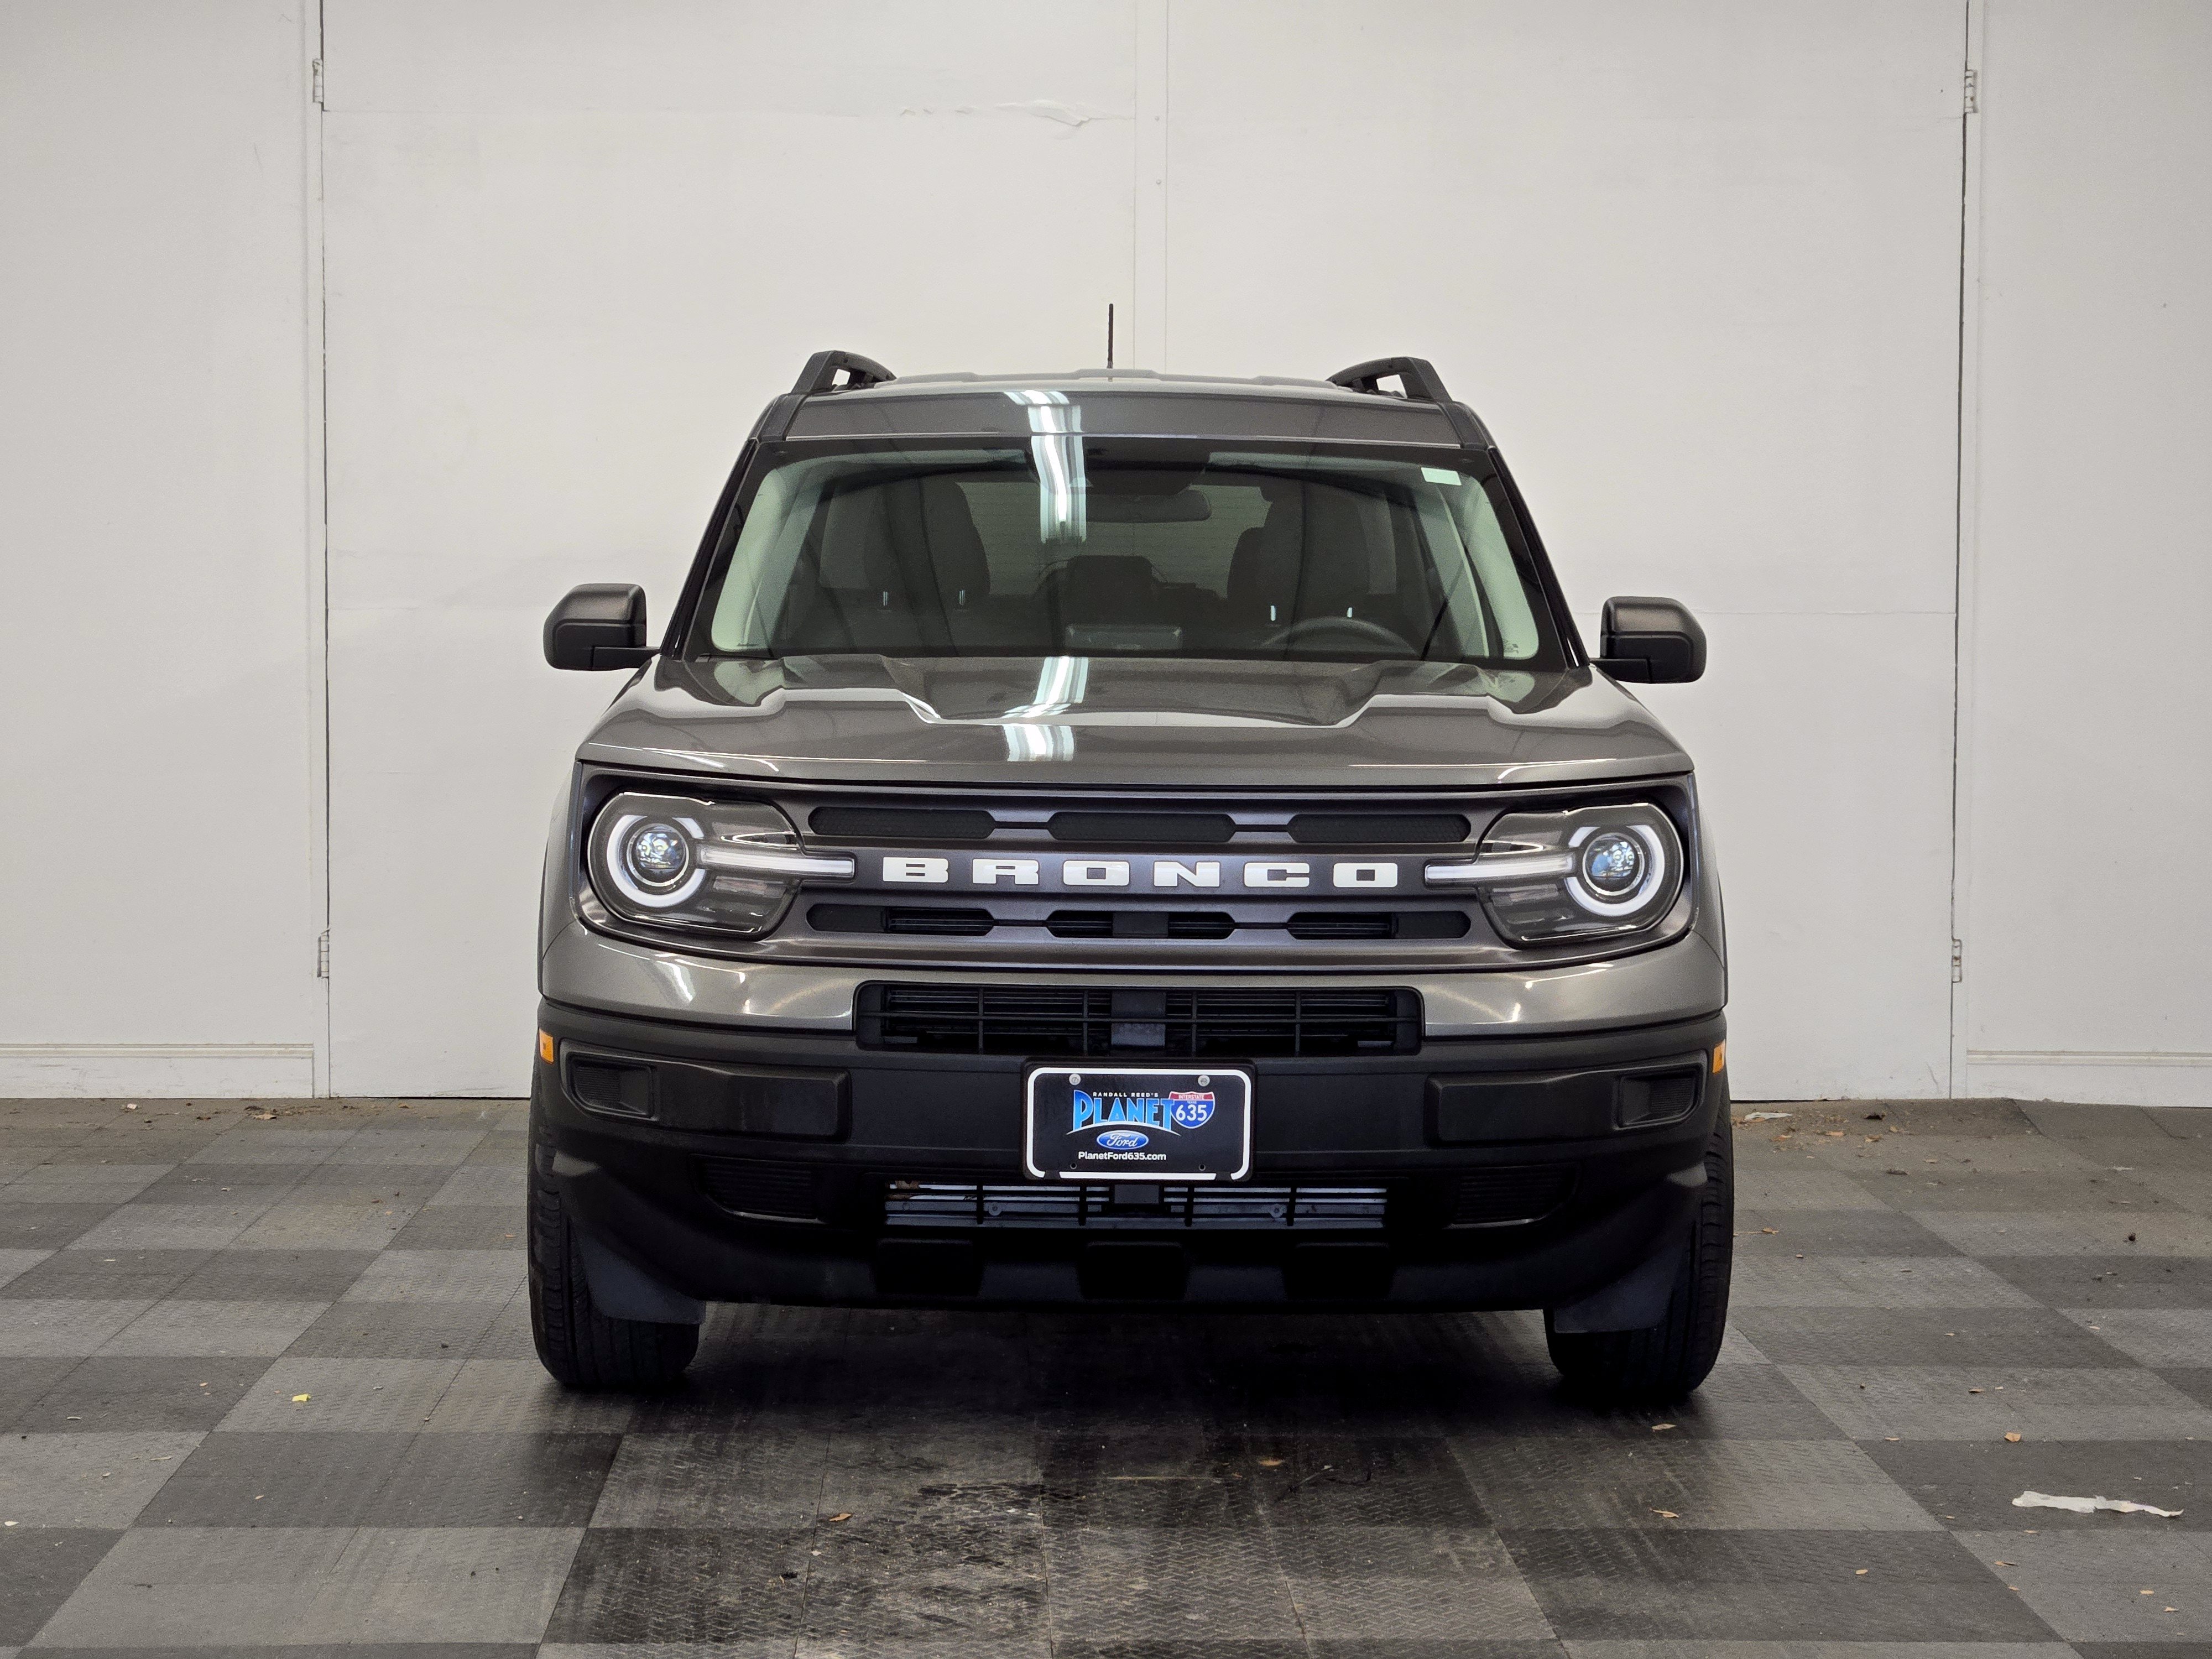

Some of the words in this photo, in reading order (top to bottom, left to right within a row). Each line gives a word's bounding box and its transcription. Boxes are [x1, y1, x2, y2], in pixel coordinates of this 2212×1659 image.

[883, 857, 1398, 888] BRONCO
[1073, 1089, 1175, 1131] PLANET
[1176, 1104, 1207, 1121] 635
[1107, 1134, 1138, 1147] Ford
[1078, 1151, 1167, 1161] PlanetFord635.com
